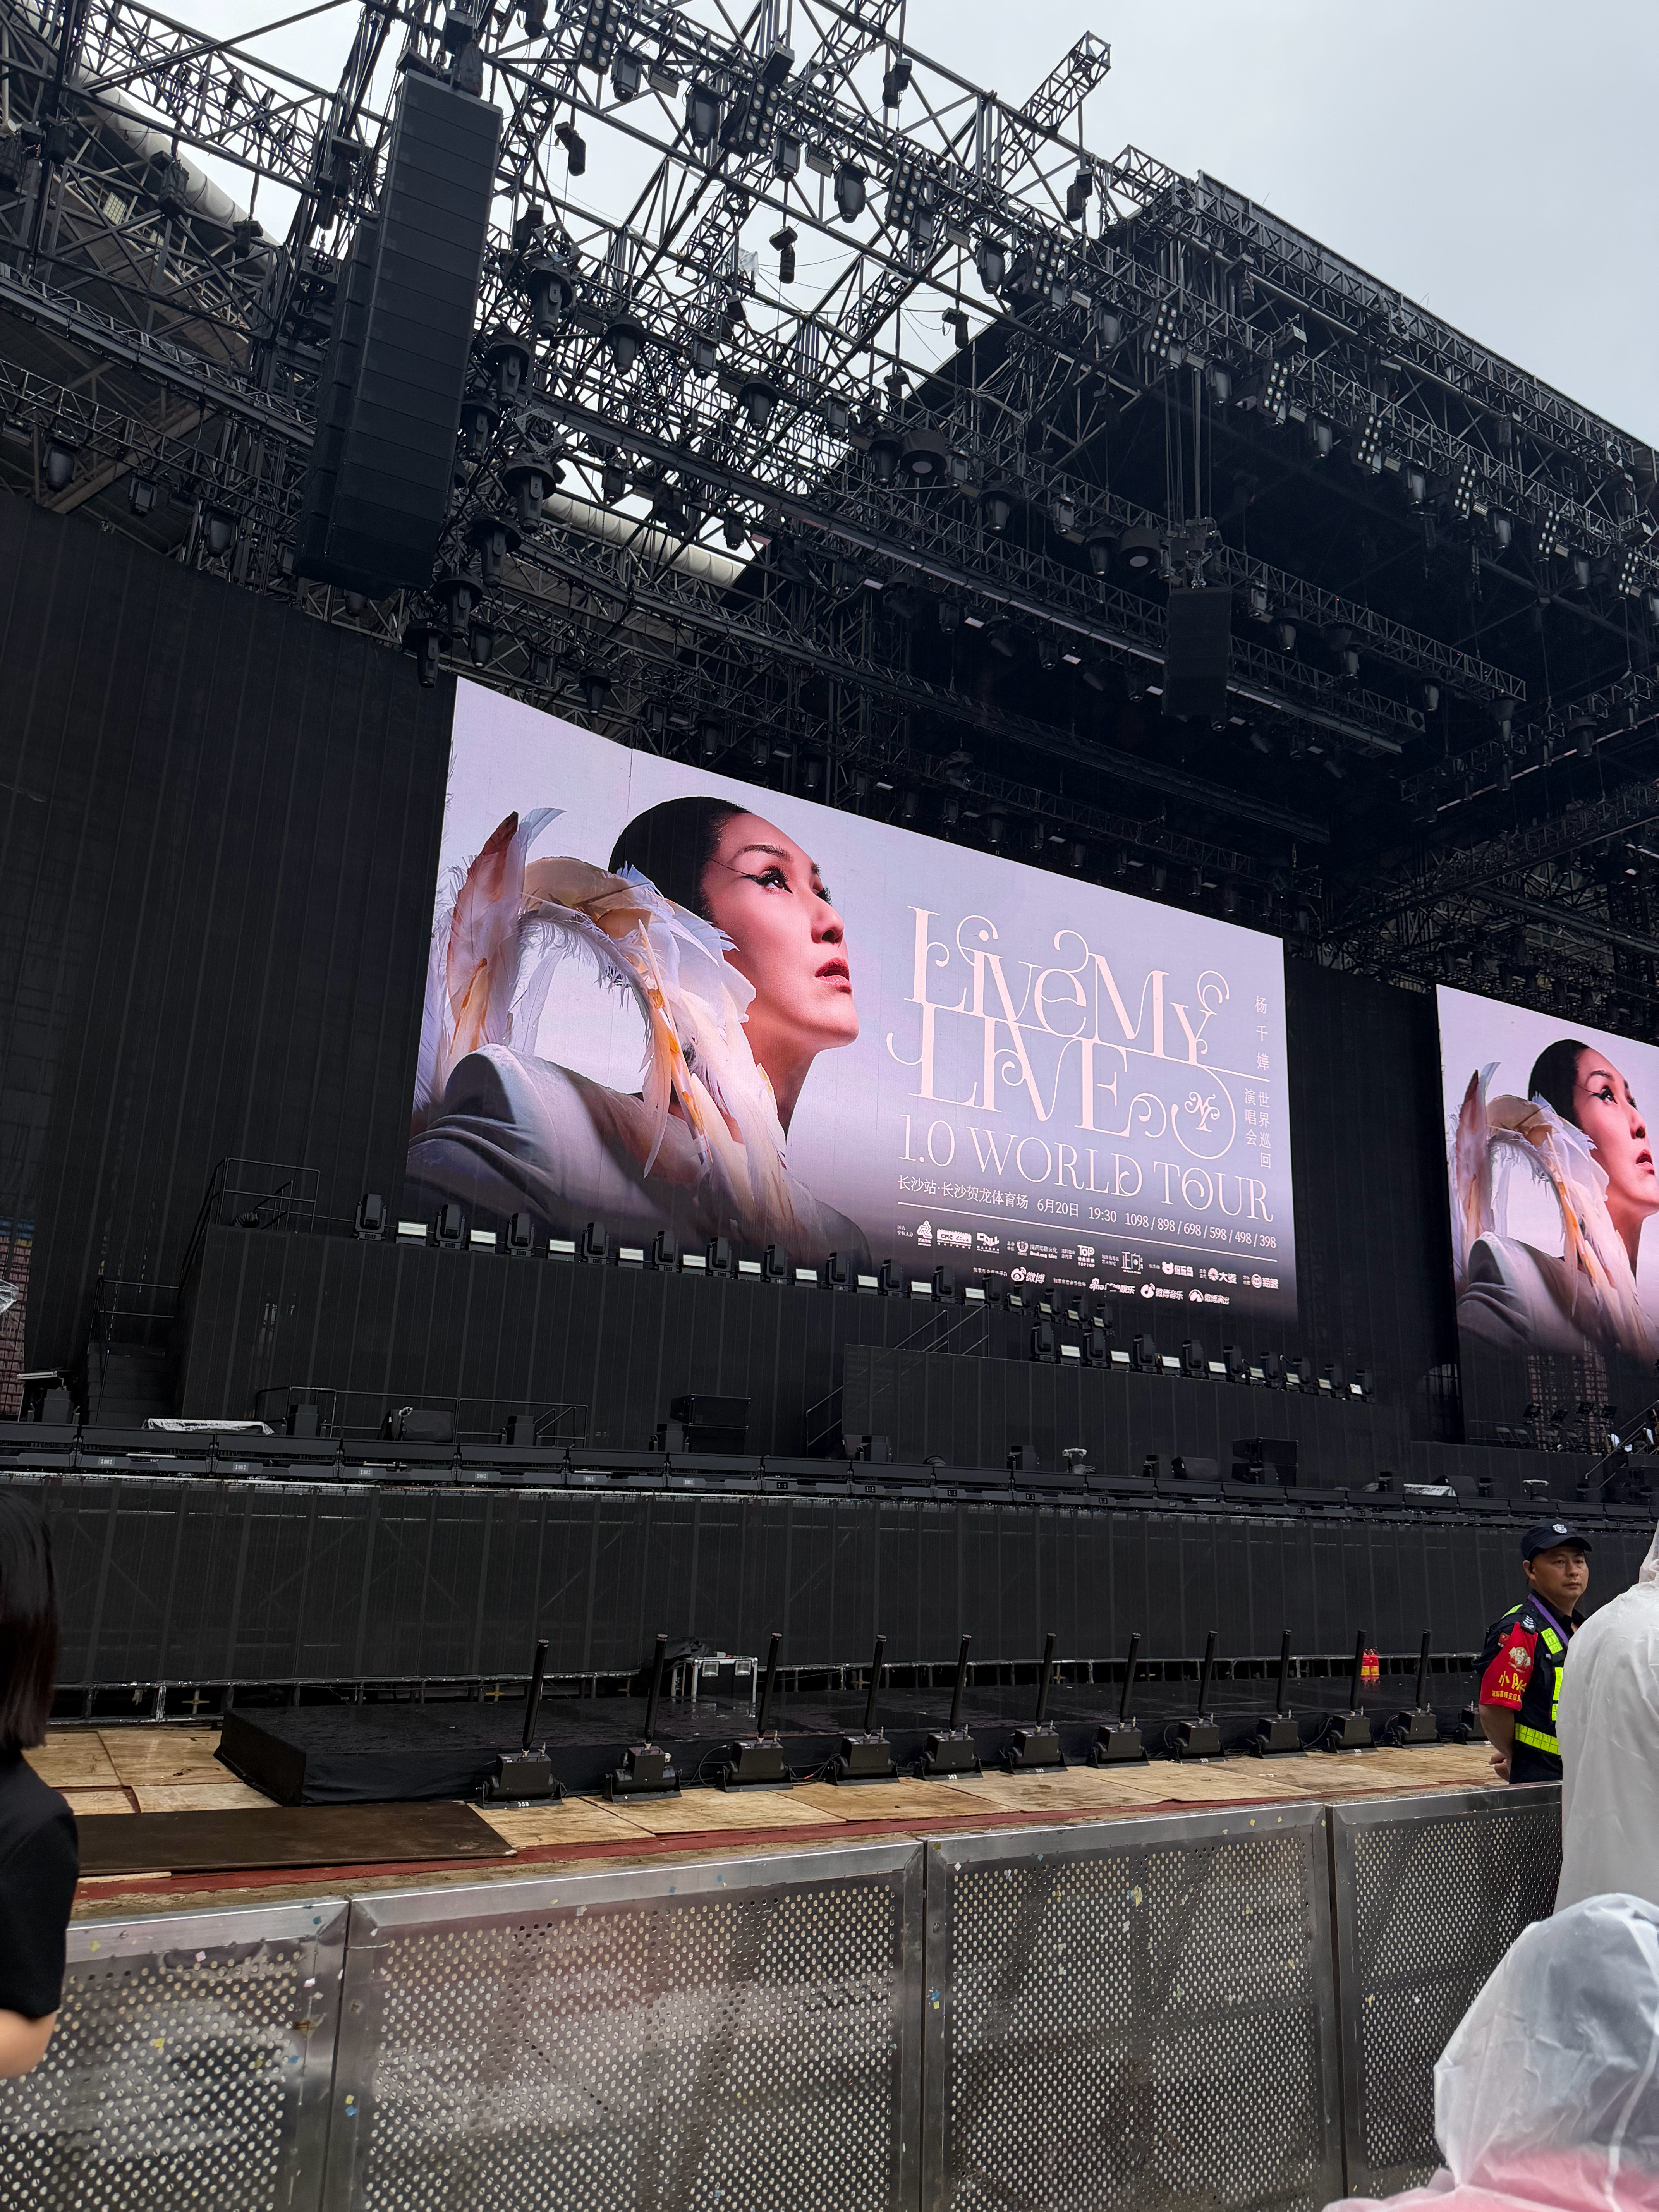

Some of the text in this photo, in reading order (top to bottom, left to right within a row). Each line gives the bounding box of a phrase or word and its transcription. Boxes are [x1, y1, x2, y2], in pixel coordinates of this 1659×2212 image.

[1244, 1088, 1256, 1146] 演唱会
[1257, 1091, 1271, 1170] 世界巡回
[898, 1114, 1274, 1223] 1.0 WORLD TOUR
[1037, 1199, 1079, 1217] 6月20日
[1089, 1207, 1117, 1223] 19:30
[1125, 1212, 1149, 1228] 1098
[1157, 1218, 1175, 1232] 898
[1183, 1222, 1201, 1237] 698
[1209, 1226, 1227, 1241] 598
[1234, 1231, 1252, 1245] 498
[1259, 1235, 1277, 1249] 398
[1026, 1271, 1045, 1284] 微博
[1219, 1272, 1237, 1284] 大麦
